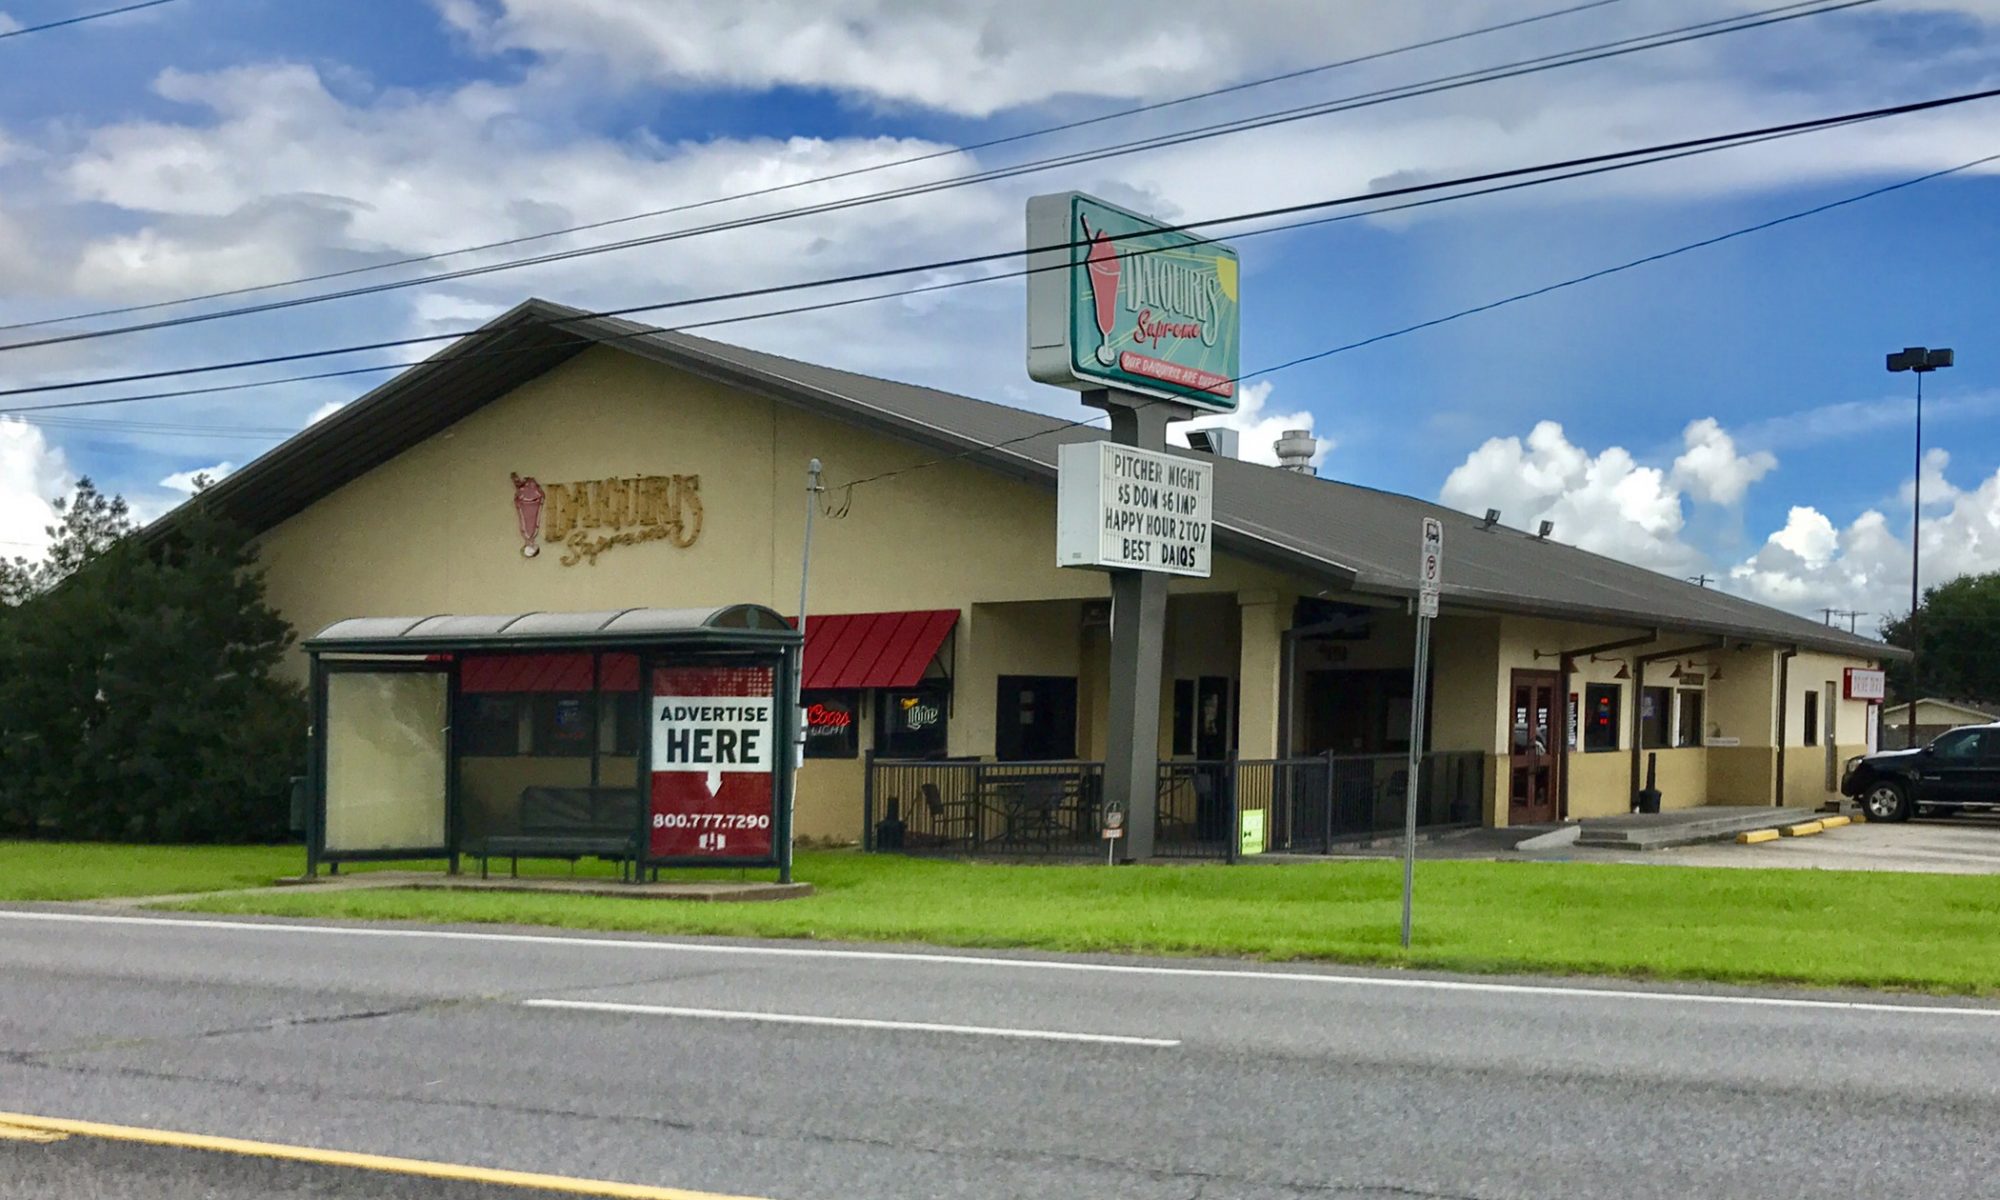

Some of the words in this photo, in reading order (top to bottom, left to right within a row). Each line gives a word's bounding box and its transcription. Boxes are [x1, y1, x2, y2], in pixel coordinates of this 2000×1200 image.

[1114, 454, 1163, 483] PITCHER
[1168, 465, 1201, 491] NIGHT
[1133, 485, 1158, 510] DOM
[1176, 492, 1197, 515] IMP
[1105, 507, 1144, 534] HAPPY
[1146, 515, 1176, 539] HOUR
[1123, 537, 1151, 562] BEST
[1162, 543, 1195, 568] DAIQS
[660, 706, 768, 722] ADVERTISE
[808, 703, 850, 726] Coors
[811, 725, 845, 736] LIGHT
[667, 728, 760, 764] HERE
[653, 813, 770, 829] 800.777.7290
